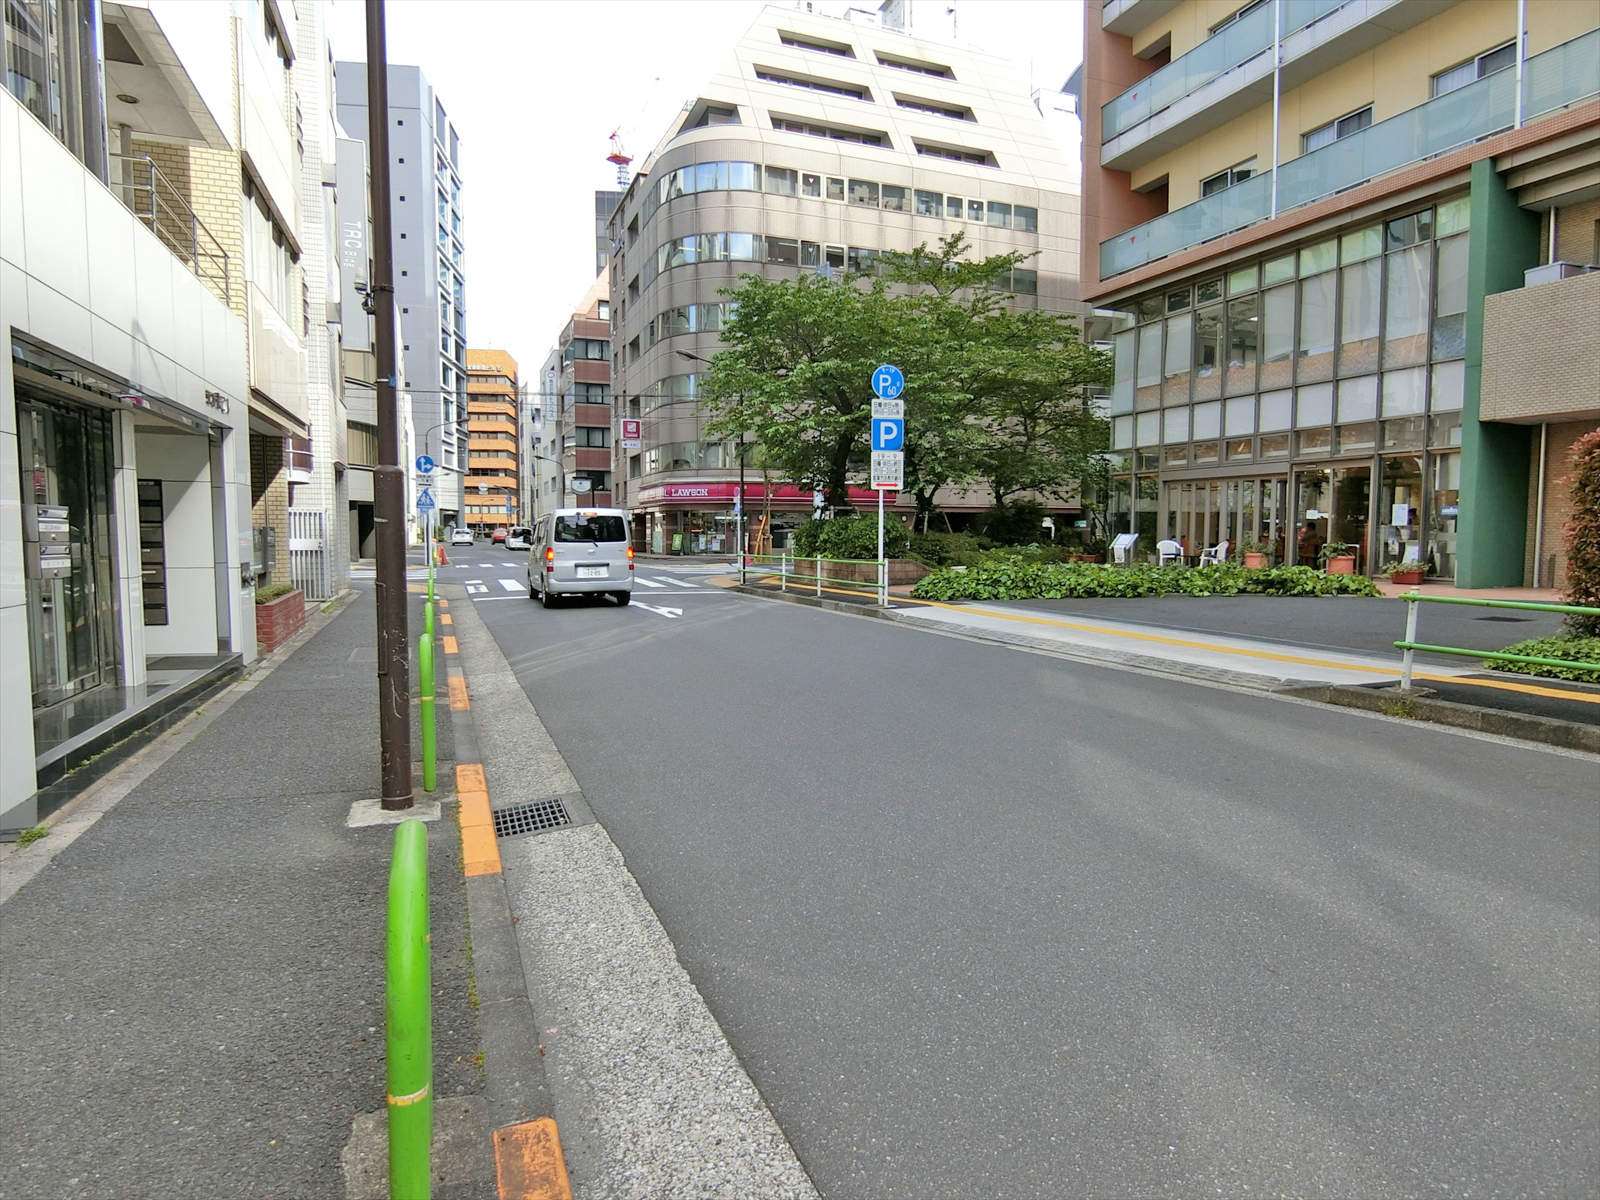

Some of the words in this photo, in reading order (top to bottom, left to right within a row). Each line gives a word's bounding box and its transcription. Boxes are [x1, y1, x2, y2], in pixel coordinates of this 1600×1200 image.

[344, 221, 362, 248] TRC
[879, 374, 892, 395] P
[887, 386, 897, 395] 60
[880, 421, 898, 448] P
[671, 488, 709, 497] LAWSON
